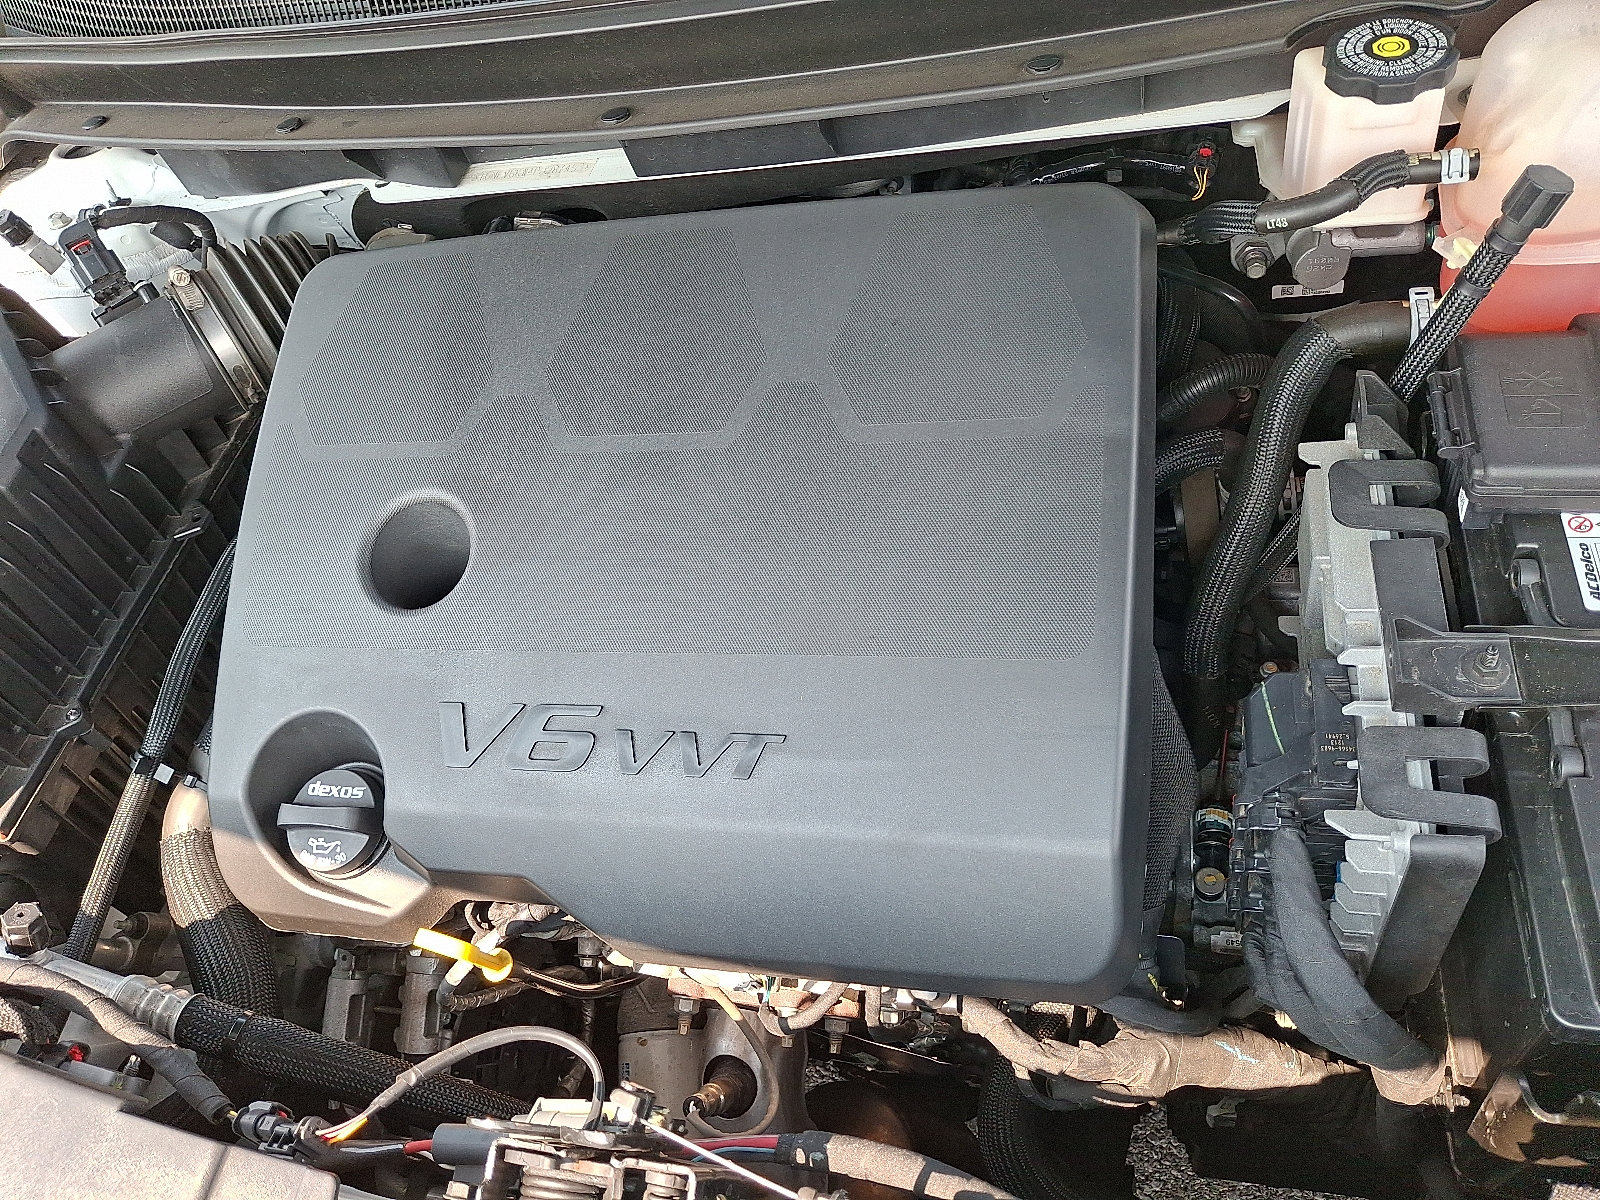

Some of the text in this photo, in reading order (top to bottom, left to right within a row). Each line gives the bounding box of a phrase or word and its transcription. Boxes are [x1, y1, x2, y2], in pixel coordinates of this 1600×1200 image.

[1382, 18, 1414, 26] BOUCHON
[1389, 56, 1413, 66] CLEAN
[1368, 69, 1389, 77] FROM
[1579, 542, 1600, 601] ACDelco
[438, 701, 788, 781] V6 VVT
[307, 780, 367, 799] dexos
